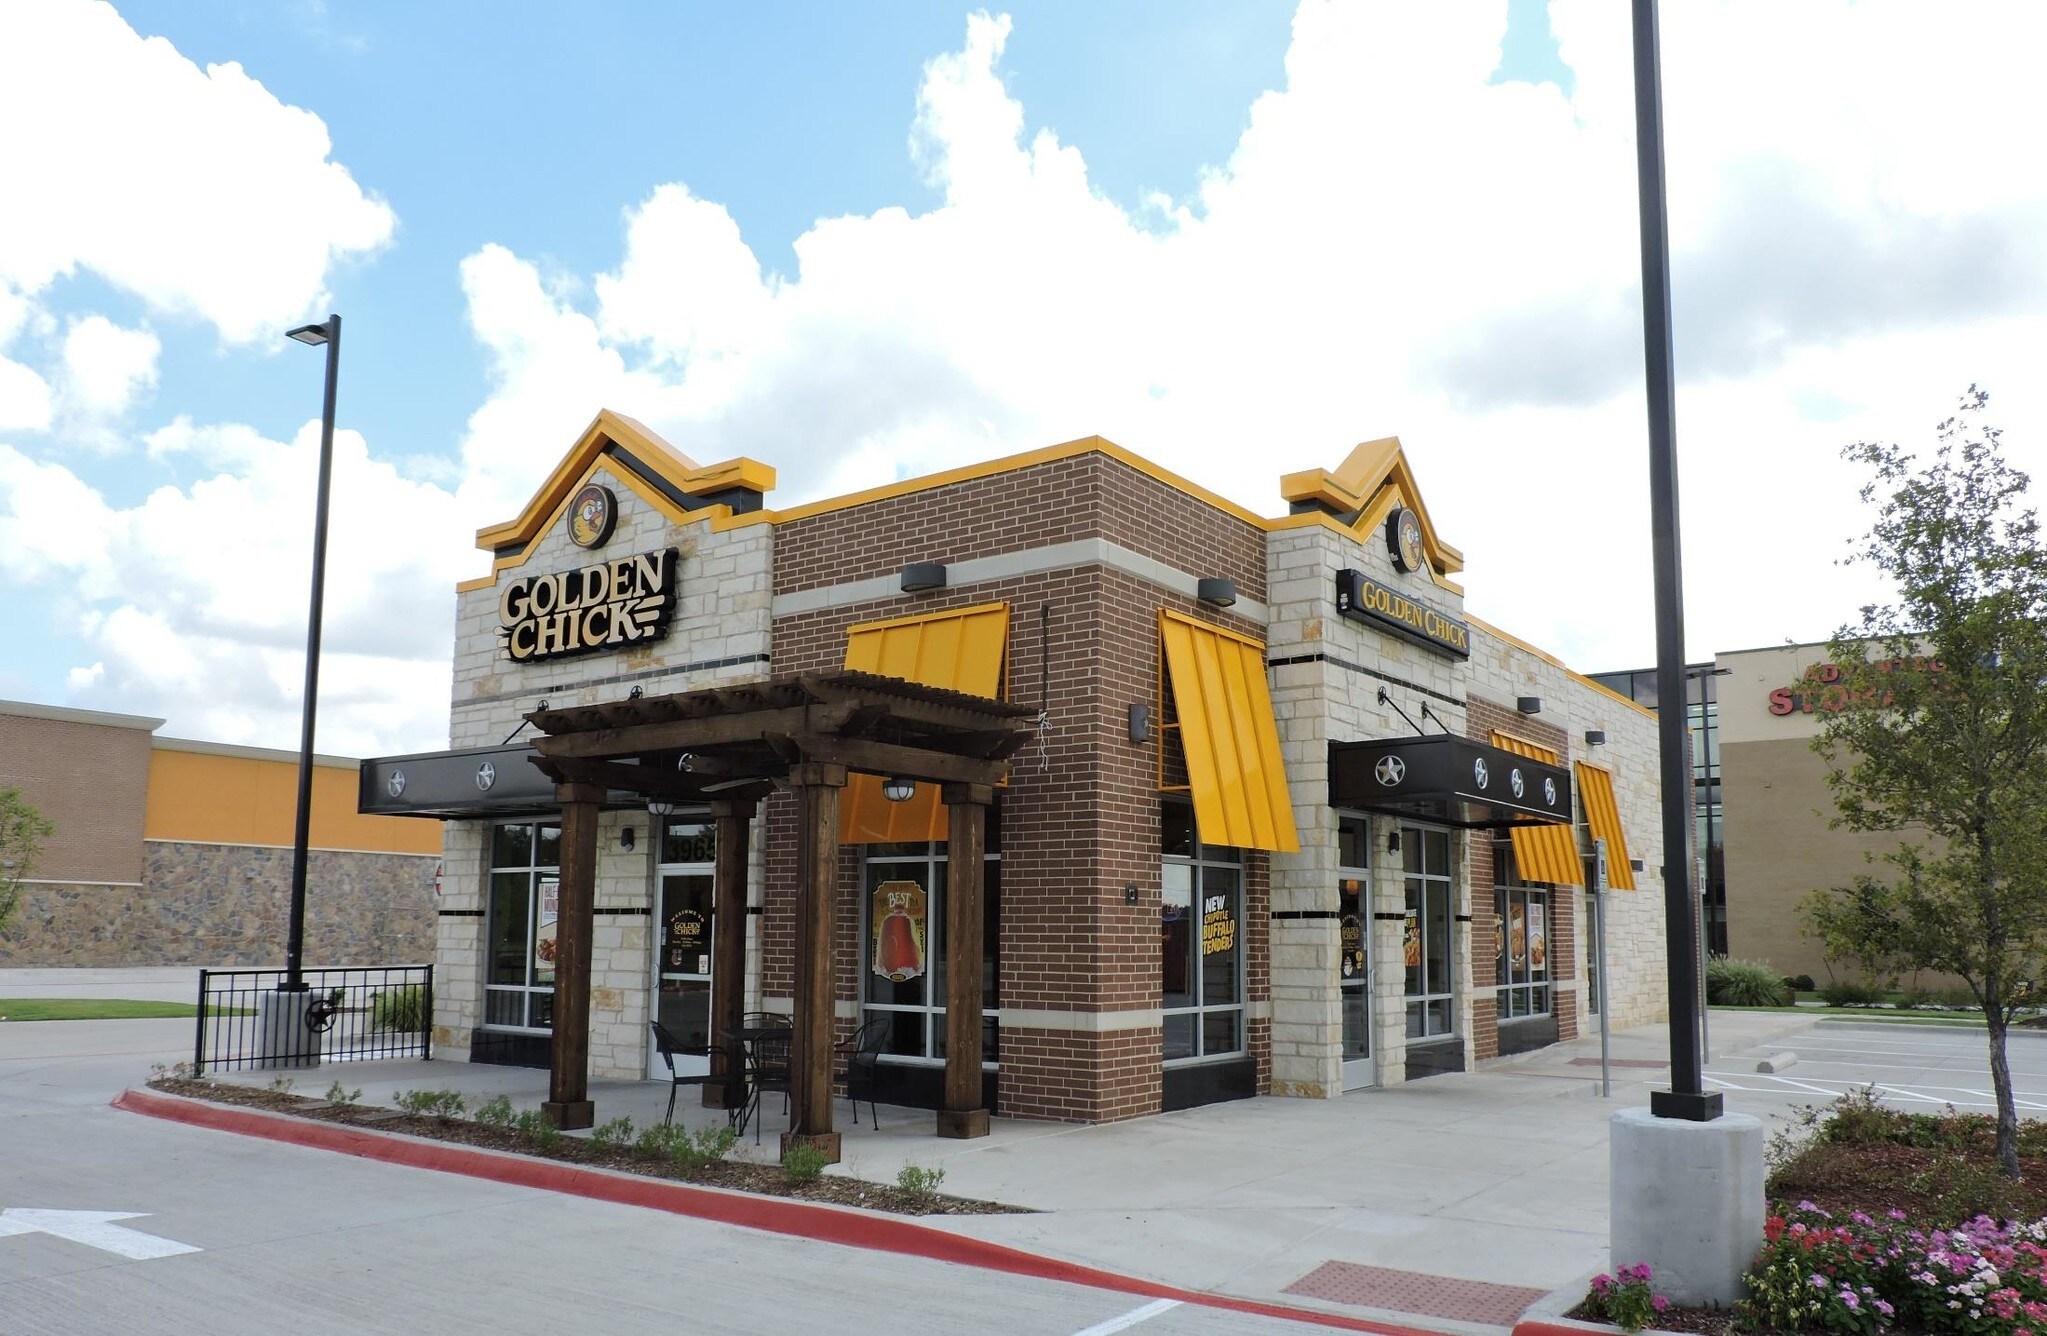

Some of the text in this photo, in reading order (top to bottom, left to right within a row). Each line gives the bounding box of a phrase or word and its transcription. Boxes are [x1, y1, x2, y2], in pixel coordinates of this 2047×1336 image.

[500, 550, 666, 625] GOLDEN
[1362, 582, 1422, 627] GOLDEN
[1425, 611, 1466, 648] CHICK
[510, 597, 645, 661] CHICK
[668, 837, 716, 861] 3965
[887, 892, 912, 908] BEST
[1205, 895, 1225, 913] NEW
[1204, 909, 1228, 923] CHIPOTLE
[674, 921, 701, 930] GOLDEN
[1203, 920, 1234, 939] BUFFALO
[1203, 936, 1233, 954] TENDERS
